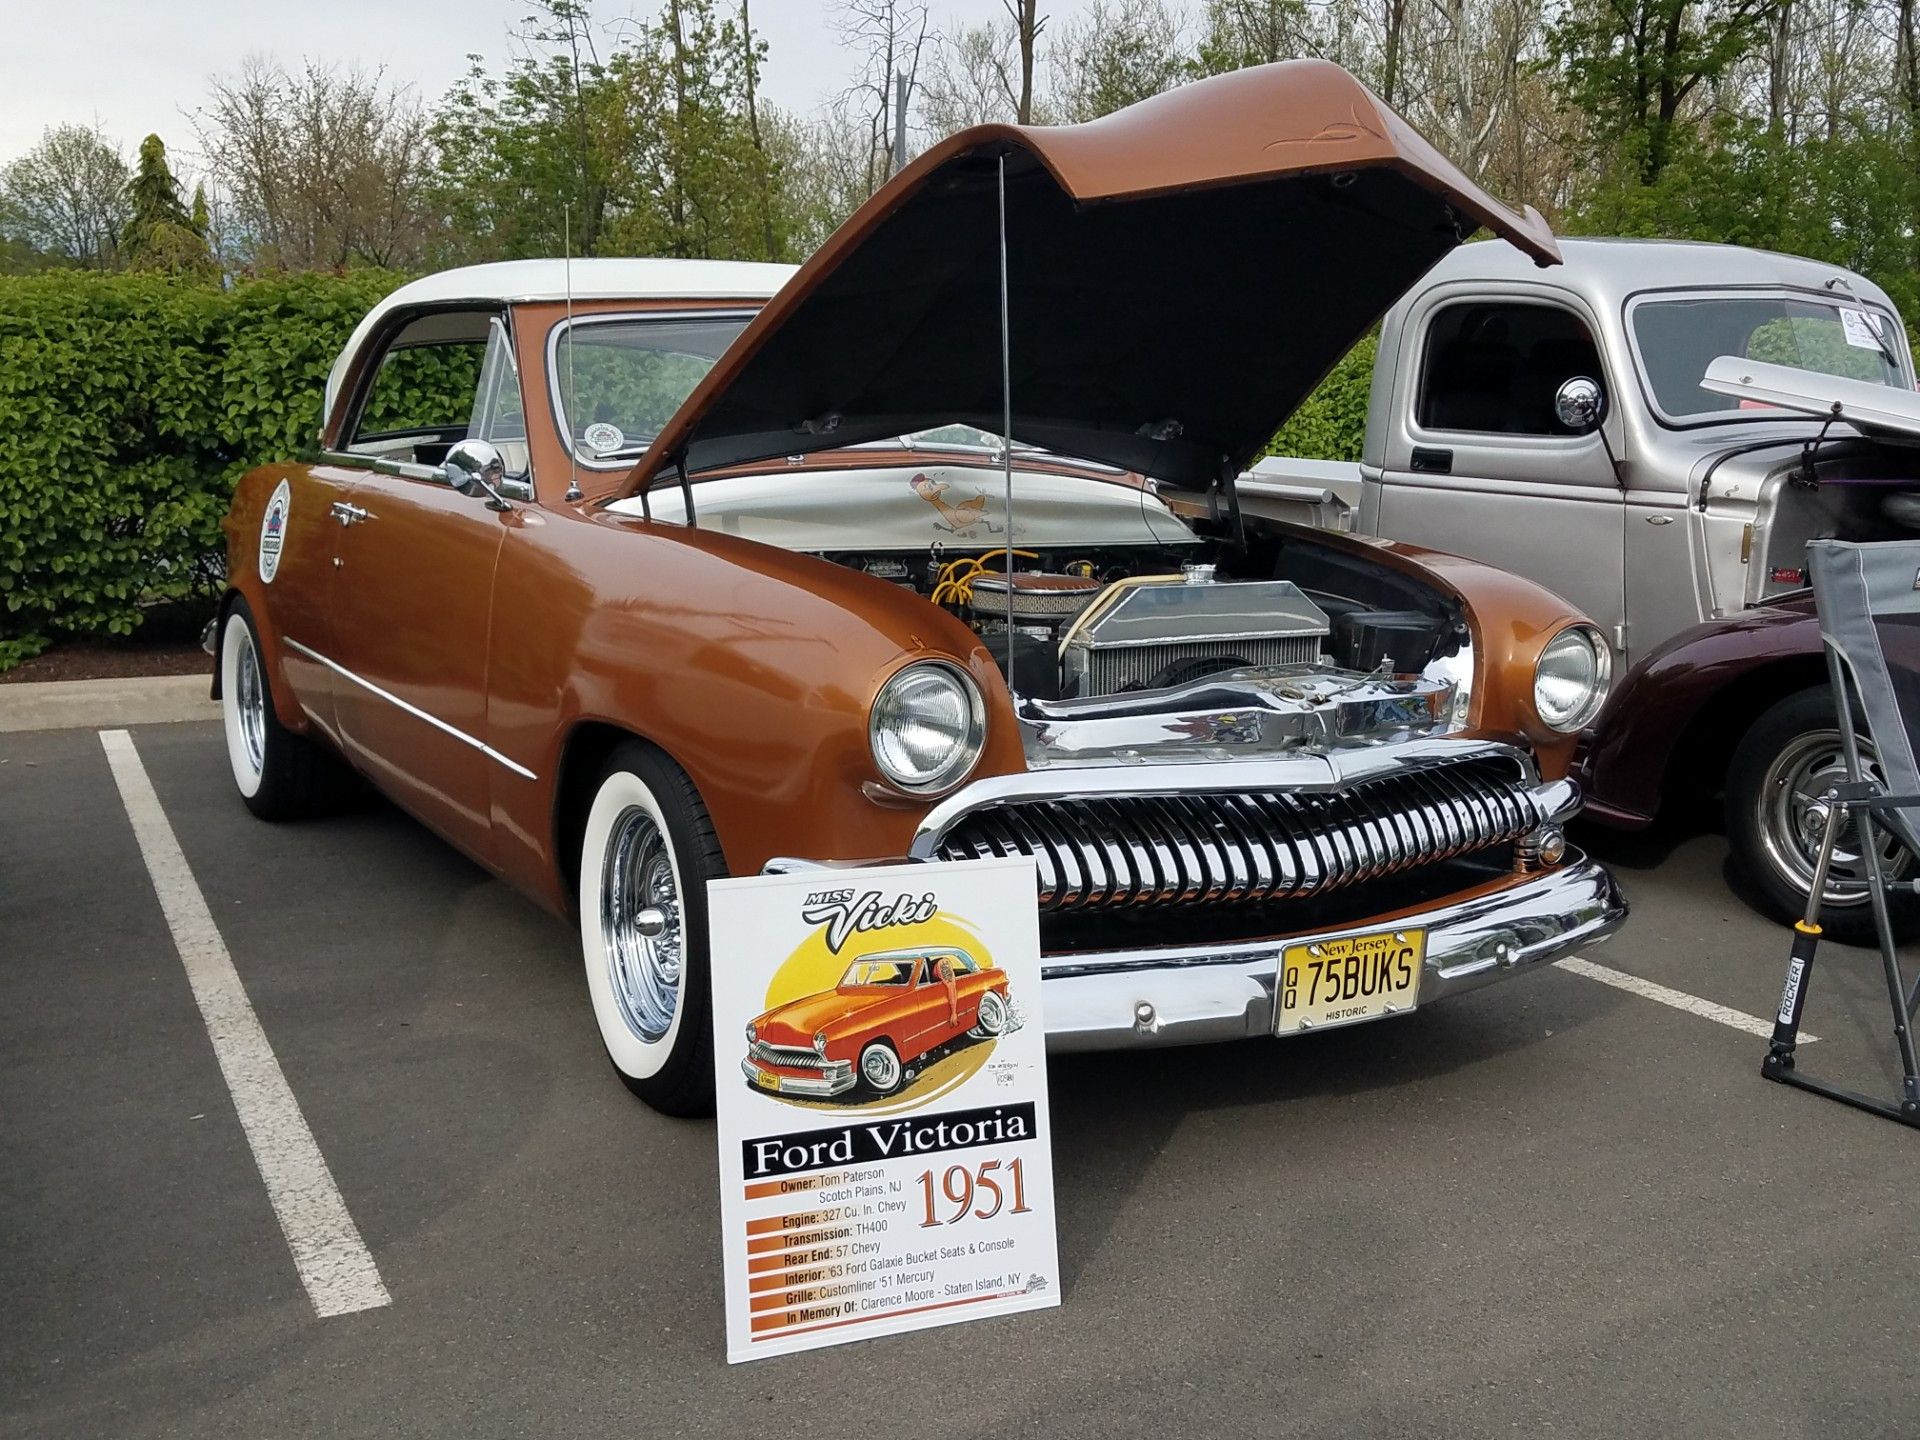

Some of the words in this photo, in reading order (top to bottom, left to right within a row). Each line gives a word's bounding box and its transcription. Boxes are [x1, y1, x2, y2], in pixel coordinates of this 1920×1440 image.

[803, 889, 855, 906] MISS
[802, 891, 938, 955] Vicki
[1318, 943, 1349, 957] New
[1350, 937, 1391, 955] Jersey
[1308, 948, 1413, 1006] 75BUKS
[1782, 965, 1801, 1017] ROCKER
[1326, 1005, 1368, 1021] HISTORIC
[752, 1129, 855, 1174] Ford
[866, 1109, 1028, 1156] Victoria
[780, 1178, 816, 1193] Owner:
[819, 1174, 840, 1187] Tom
[843, 1168, 885, 1182] Paterson
[819, 1188, 852, 1204] Scotch
[855, 1183, 887, 1197] Plains,
[889, 1180, 902, 1193] NJ
[915, 1156, 1033, 1228] 1951
[782, 1213, 819, 1229] Engine:
[822, 1208, 841, 1221] 327
[844, 1206, 860, 1218] Cu.
[863, 1204, 874, 1216] In.
[878, 1200, 907, 1213] Chevy
[783, 1226, 853, 1247] Transmission:
[856, 1220, 888, 1235] TH400
[784, 1253, 809, 1266] Rear
[811, 1248, 833, 1261] End:
[836, 1245, 848, 1257] 57
[851, 1241, 881, 1255] Chevy
[785, 1269, 825, 1285] Interior:
[828, 1265, 843, 1278] '63
[846, 1261, 867, 1274] Ford
[869, 1255, 903, 1271] Galaxie
[906, 1249, 938, 1264] Bucket
[940, 1245, 966, 1260] Seats
[969, 1243, 976, 1255] &
[978, 1237, 1015, 1253] Console
[786, 1289, 817, 1305] Grille:
[819, 1278, 877, 1298] Customliner
[879, 1275, 893, 1288] '51
[896, 1270, 935, 1285] Mercury
[787, 1312, 797, 1324] In
[800, 1304, 841, 1322] Memory
[844, 1301, 858, 1314] Of:
[861, 1294, 902, 1310] Clarence
[905, 1288, 935, 1303] Moore
[944, 1282, 973, 1297] Staten
[975, 1275, 1005, 1290] Island,
[1008, 1272, 1021, 1285] NY
